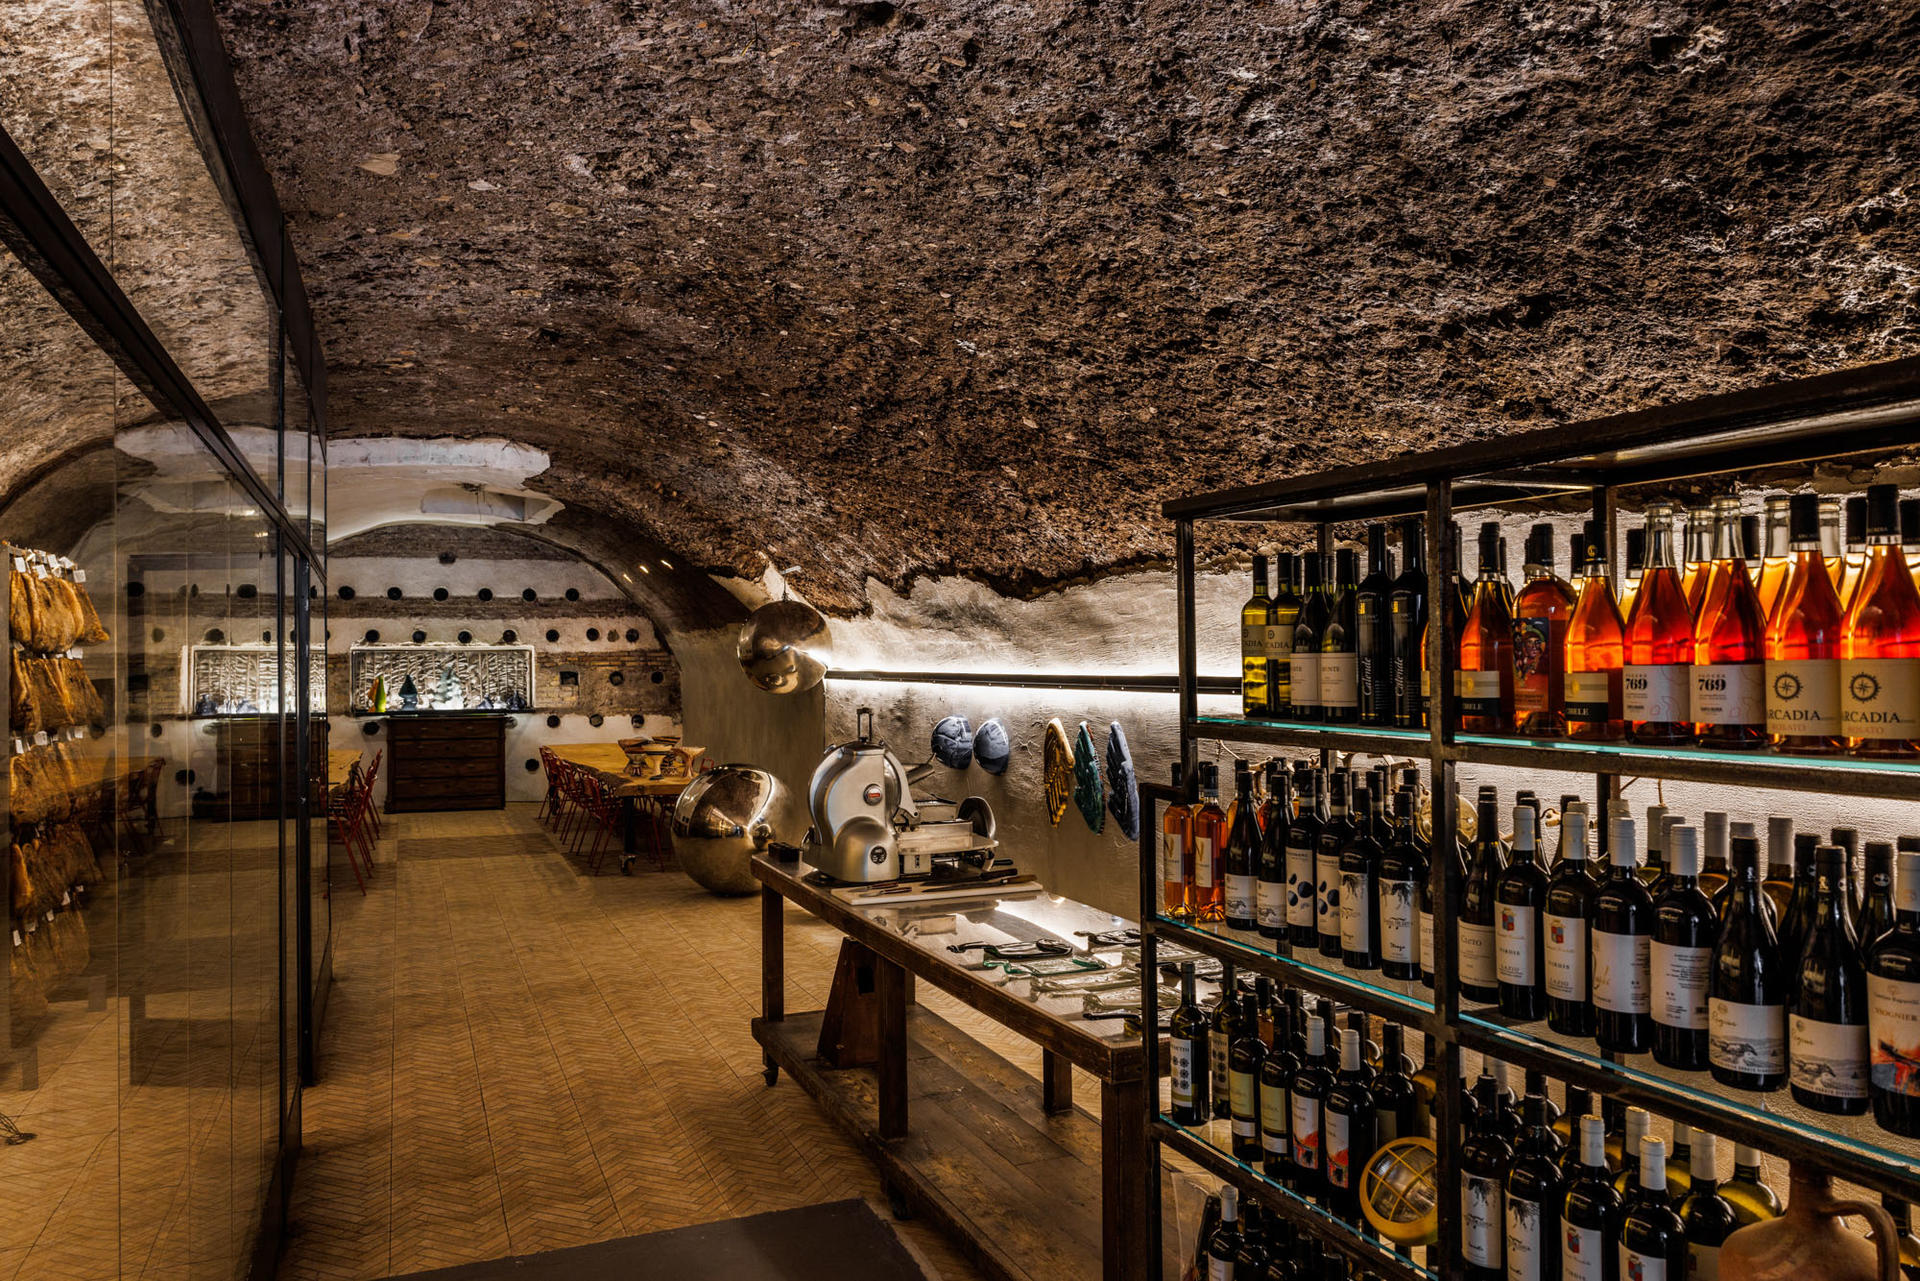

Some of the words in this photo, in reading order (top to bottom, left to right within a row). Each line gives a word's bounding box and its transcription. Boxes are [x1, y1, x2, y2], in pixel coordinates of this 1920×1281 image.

[1625, 678, 1648, 690] 769
[1698, 678, 1726, 691] 769
[1767, 709, 1821, 721] RCADIA
